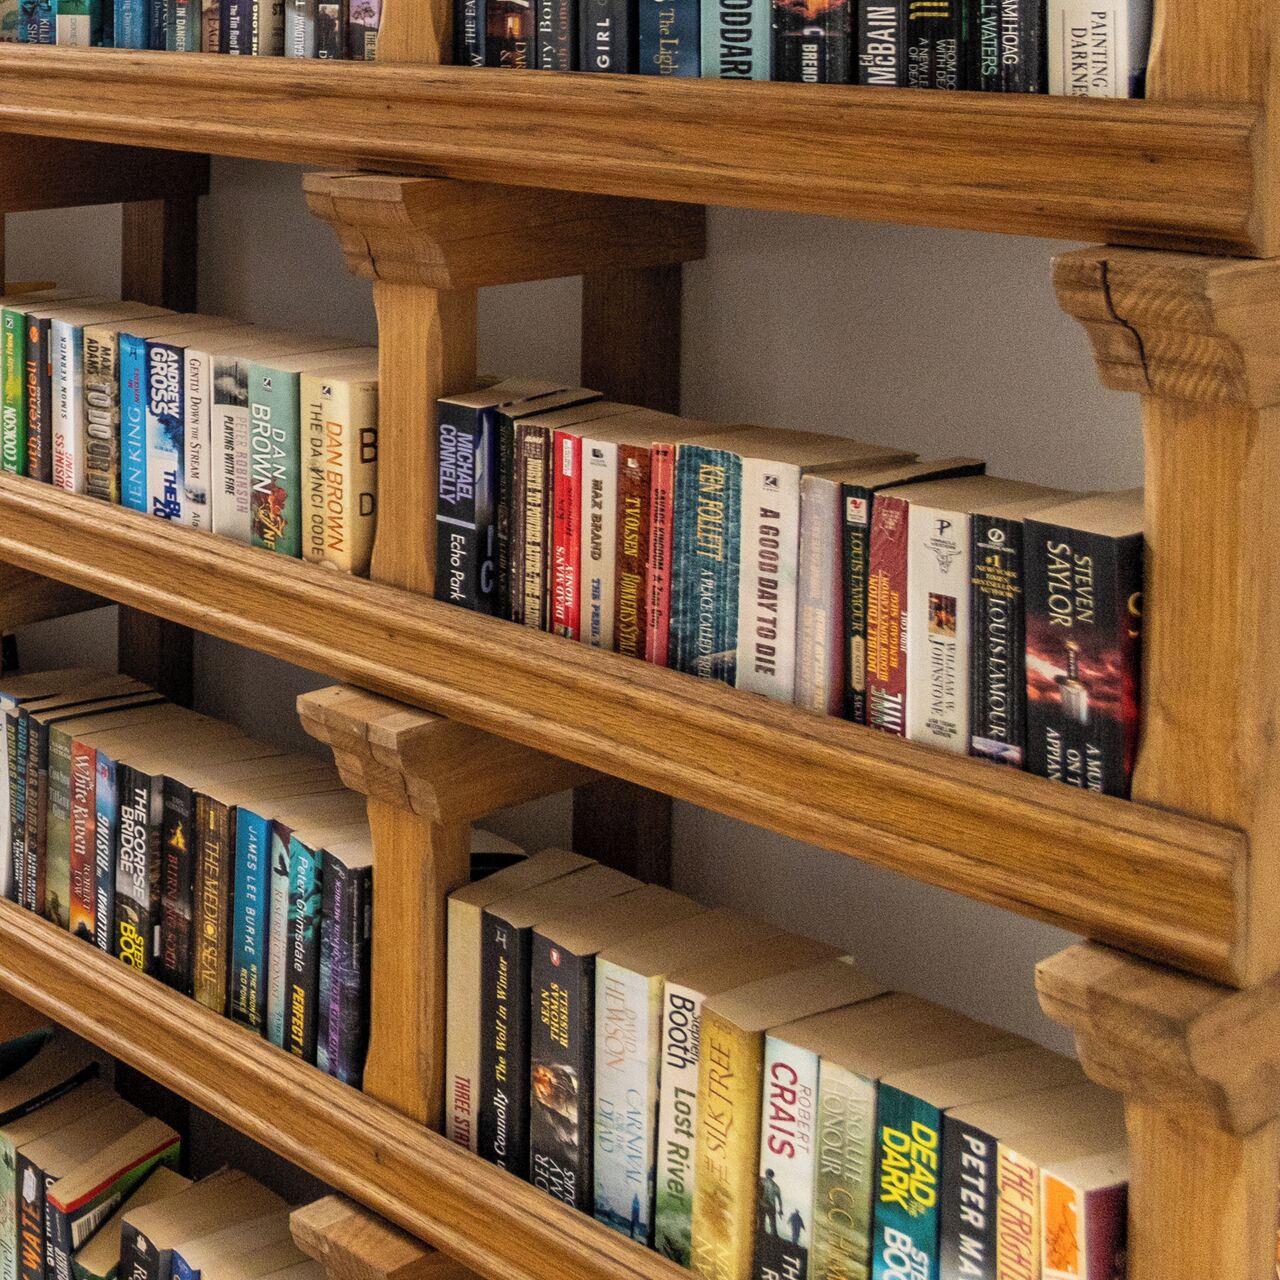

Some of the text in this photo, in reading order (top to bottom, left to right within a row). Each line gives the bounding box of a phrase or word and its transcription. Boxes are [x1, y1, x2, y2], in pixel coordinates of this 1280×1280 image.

[465, 19, 476, 45] THE
[596, 18, 610, 68] GIRL
[659, 8, 675, 35] The
[980, 16, 997, 76] WATERS
[1001, 22, 1019, 65] HOAG
[1091, 12, 1107, 88] PAINTING
[149, 347, 166, 416] GROSS
[164, 349, 180, 419] ANDREW
[3, 406, 18, 461] COOKSON
[224, 415, 234, 495] PLAYING FIRE
[250, 403, 271, 494] BROWN
[269, 427, 286, 479] DAN
[440, 424, 456, 504] CONNELLY
[456, 432, 472, 500] MICHAEL
[310, 403, 325, 555] THE VINCI CODE
[326, 422, 343, 552] DAN BROWN
[697, 464, 725, 561] KEN FOLLETT
[450, 533, 465, 600] Echo Park
[592, 513, 602, 560] BRAND
[564, 566, 573, 609] MONEY
[753, 523, 780, 676] GOOD DAY TO DIE
[1048, 541, 1072, 629] SAYLOR
[1075, 554, 1093, 625] STEVEN
[987, 598, 1008, 651] LOUIS
[120, 805, 132, 875] BRIDGE
[132, 824, 147, 903] CORPSE
[243, 904, 256, 955] BURKE
[290, 899, 307, 1042] Grimsdale PERFECT
[549, 982, 559, 1041] THOMAS
[559, 989, 569, 1048] RUSSELL
[667, 992, 695, 1070] Booth
[494, 957, 509, 1155] Connolly Winter
[455, 1075, 471, 1117] THREE
[767, 1062, 798, 1159] CRAIS
[797, 1083, 812, 1153] ROBERT
[665, 1087, 694, 1201] Lost River
[880, 1126, 911, 1210] DARK
[910, 1120, 938, 1207] DEAD
[960, 1134, 987, 1229] PETER
